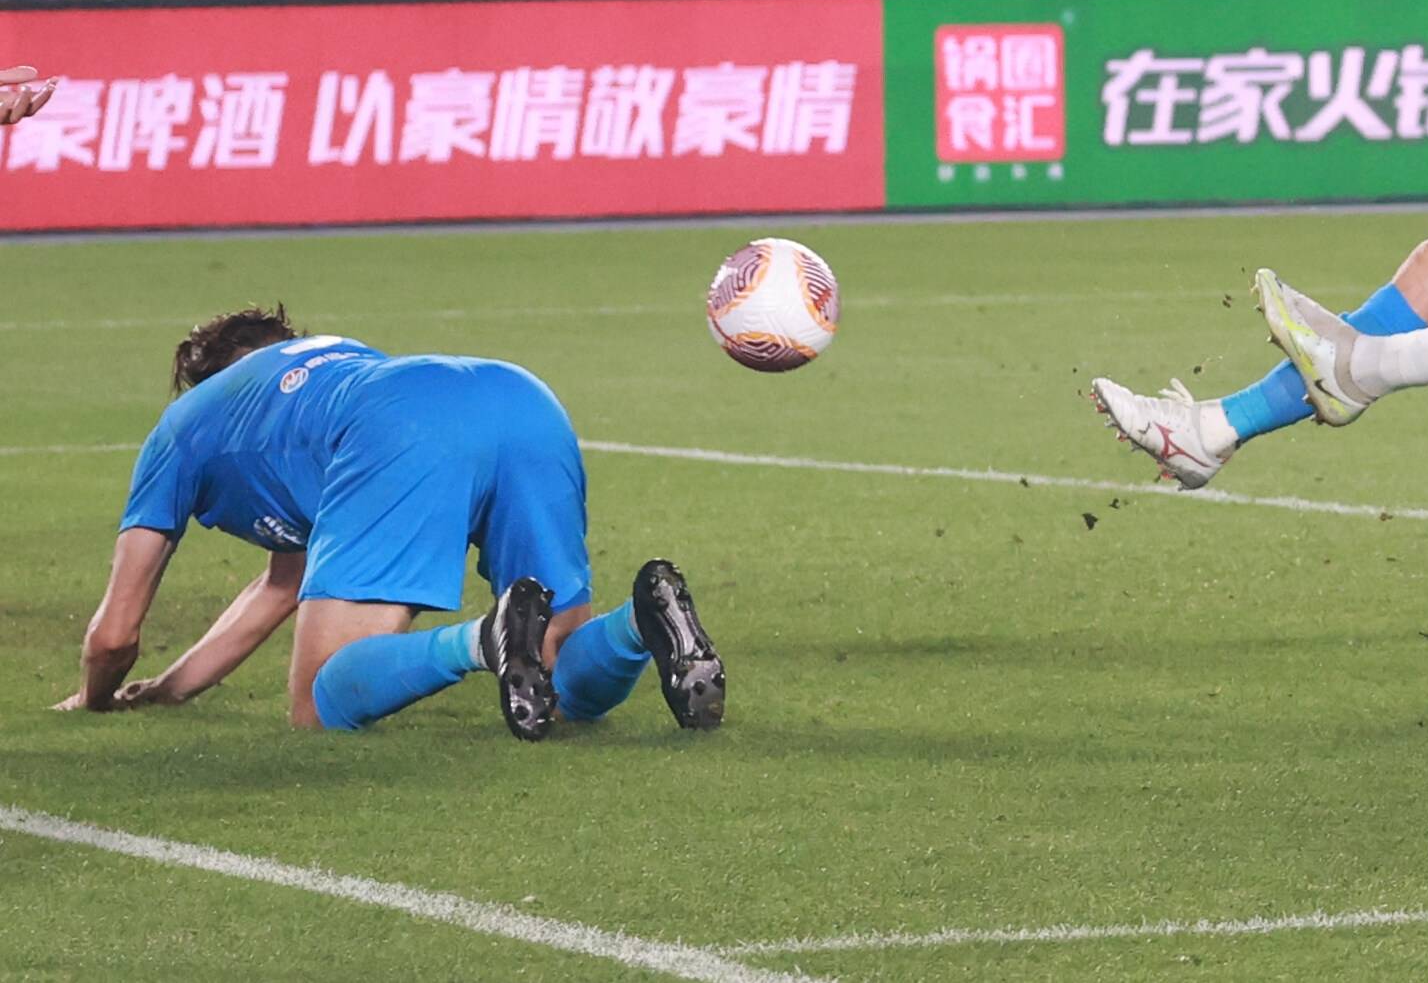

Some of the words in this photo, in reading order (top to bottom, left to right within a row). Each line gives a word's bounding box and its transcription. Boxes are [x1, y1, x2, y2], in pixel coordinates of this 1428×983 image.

[0, 71, 289, 172] 豪啤酒
[307, 60, 859, 166] 以豪情敬豪情
[946, 94, 1057, 151] 食汇
